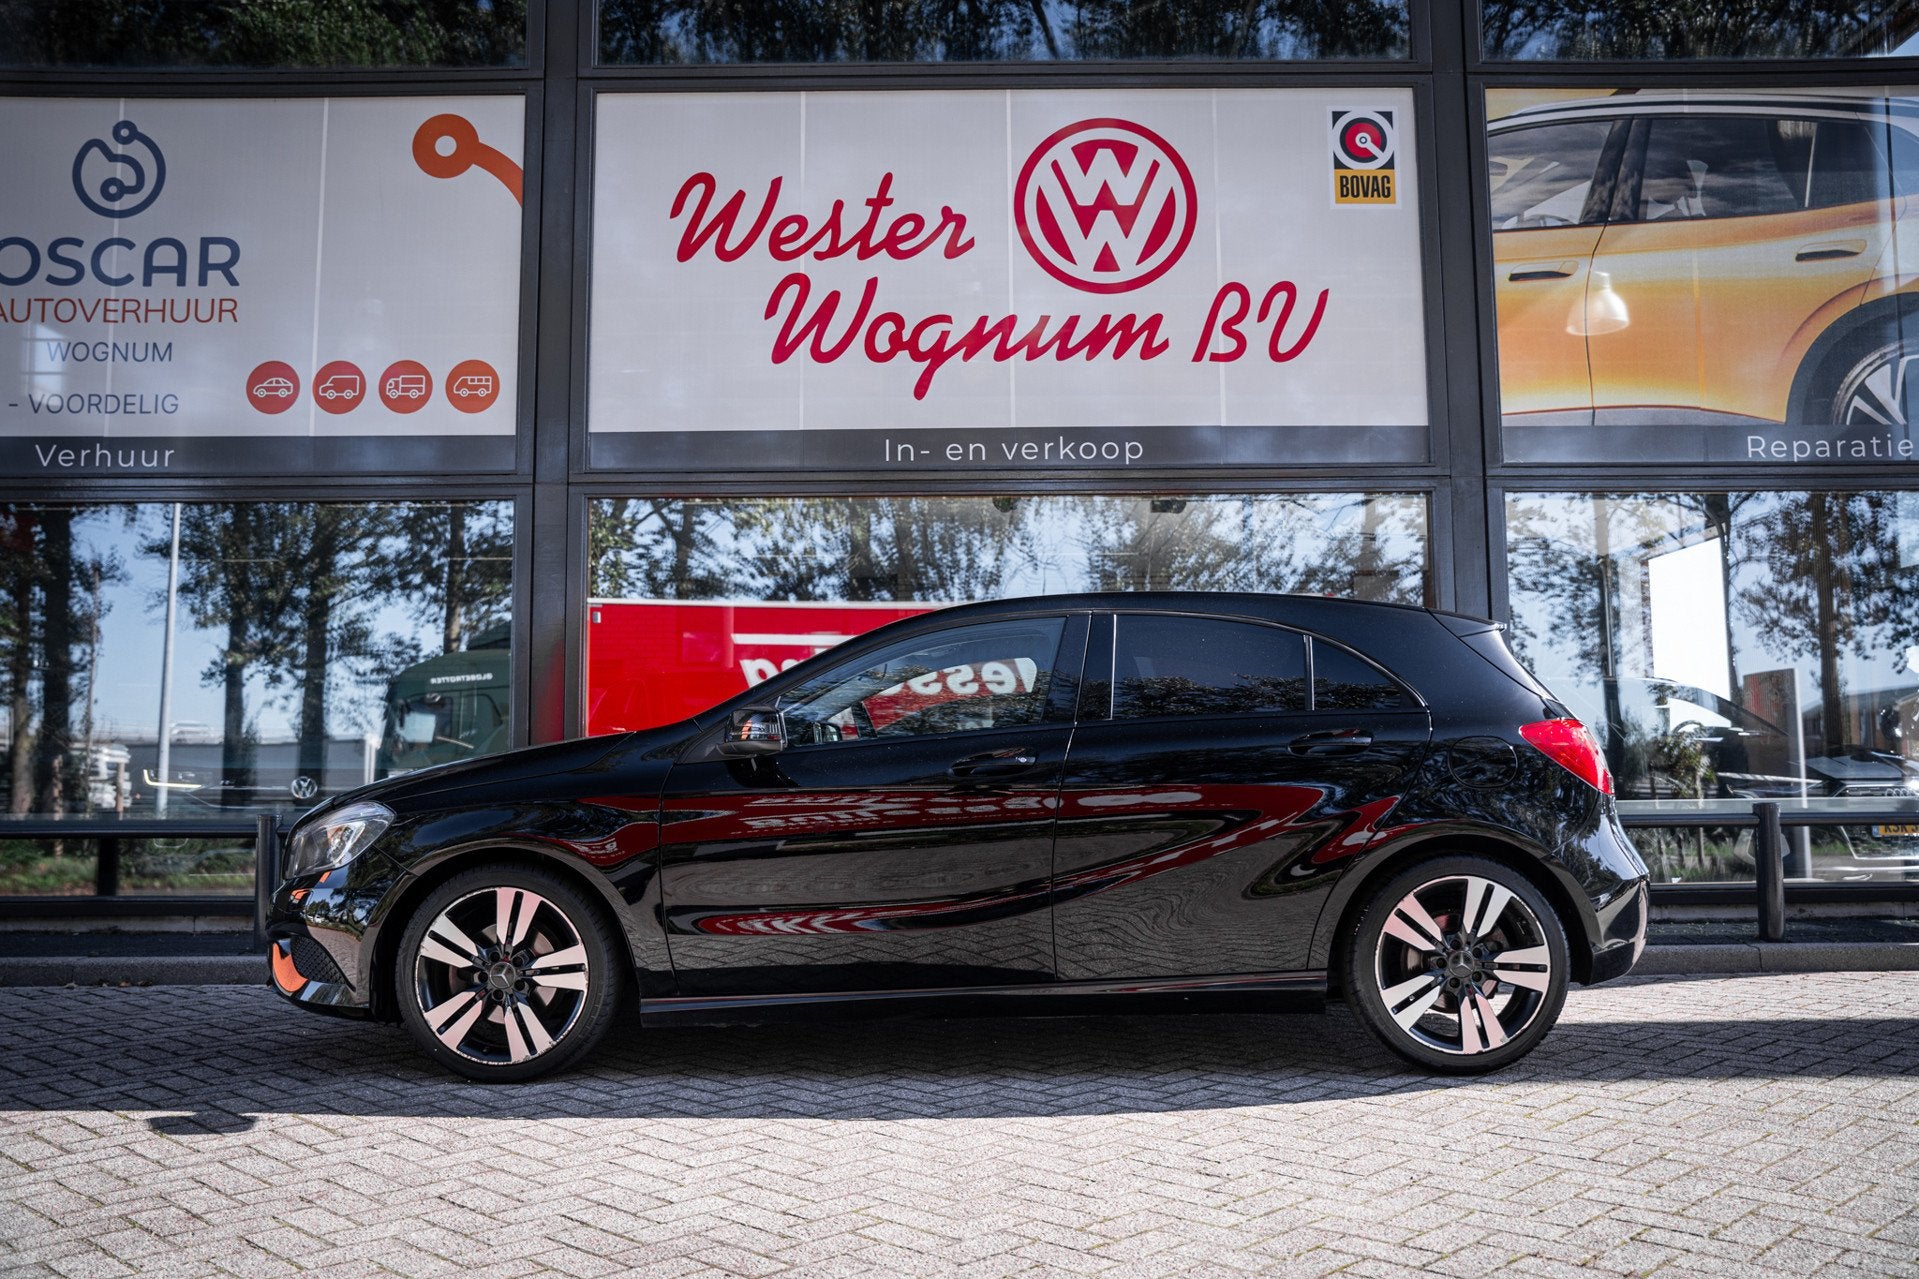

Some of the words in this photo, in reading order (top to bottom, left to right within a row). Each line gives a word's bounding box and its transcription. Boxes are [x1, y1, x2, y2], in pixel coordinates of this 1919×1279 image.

[1339, 175, 1391, 198] BOVAG
[670, 172, 974, 262] Wester
[0, 236, 241, 287] OSCAR
[764, 273, 1169, 400] Wognum
[1191, 281, 1329, 364] BV
[47, 341, 173, 363] WOGNUM
[28, 393, 179, 415] VOORDELIG
[35, 442, 175, 467] Verhuur
[885, 438, 930, 462] In-
[945, 442, 986, 461] en
[1001, 436, 1144, 465] verkoop
[1746, 433, 1914, 462] Reparatie
